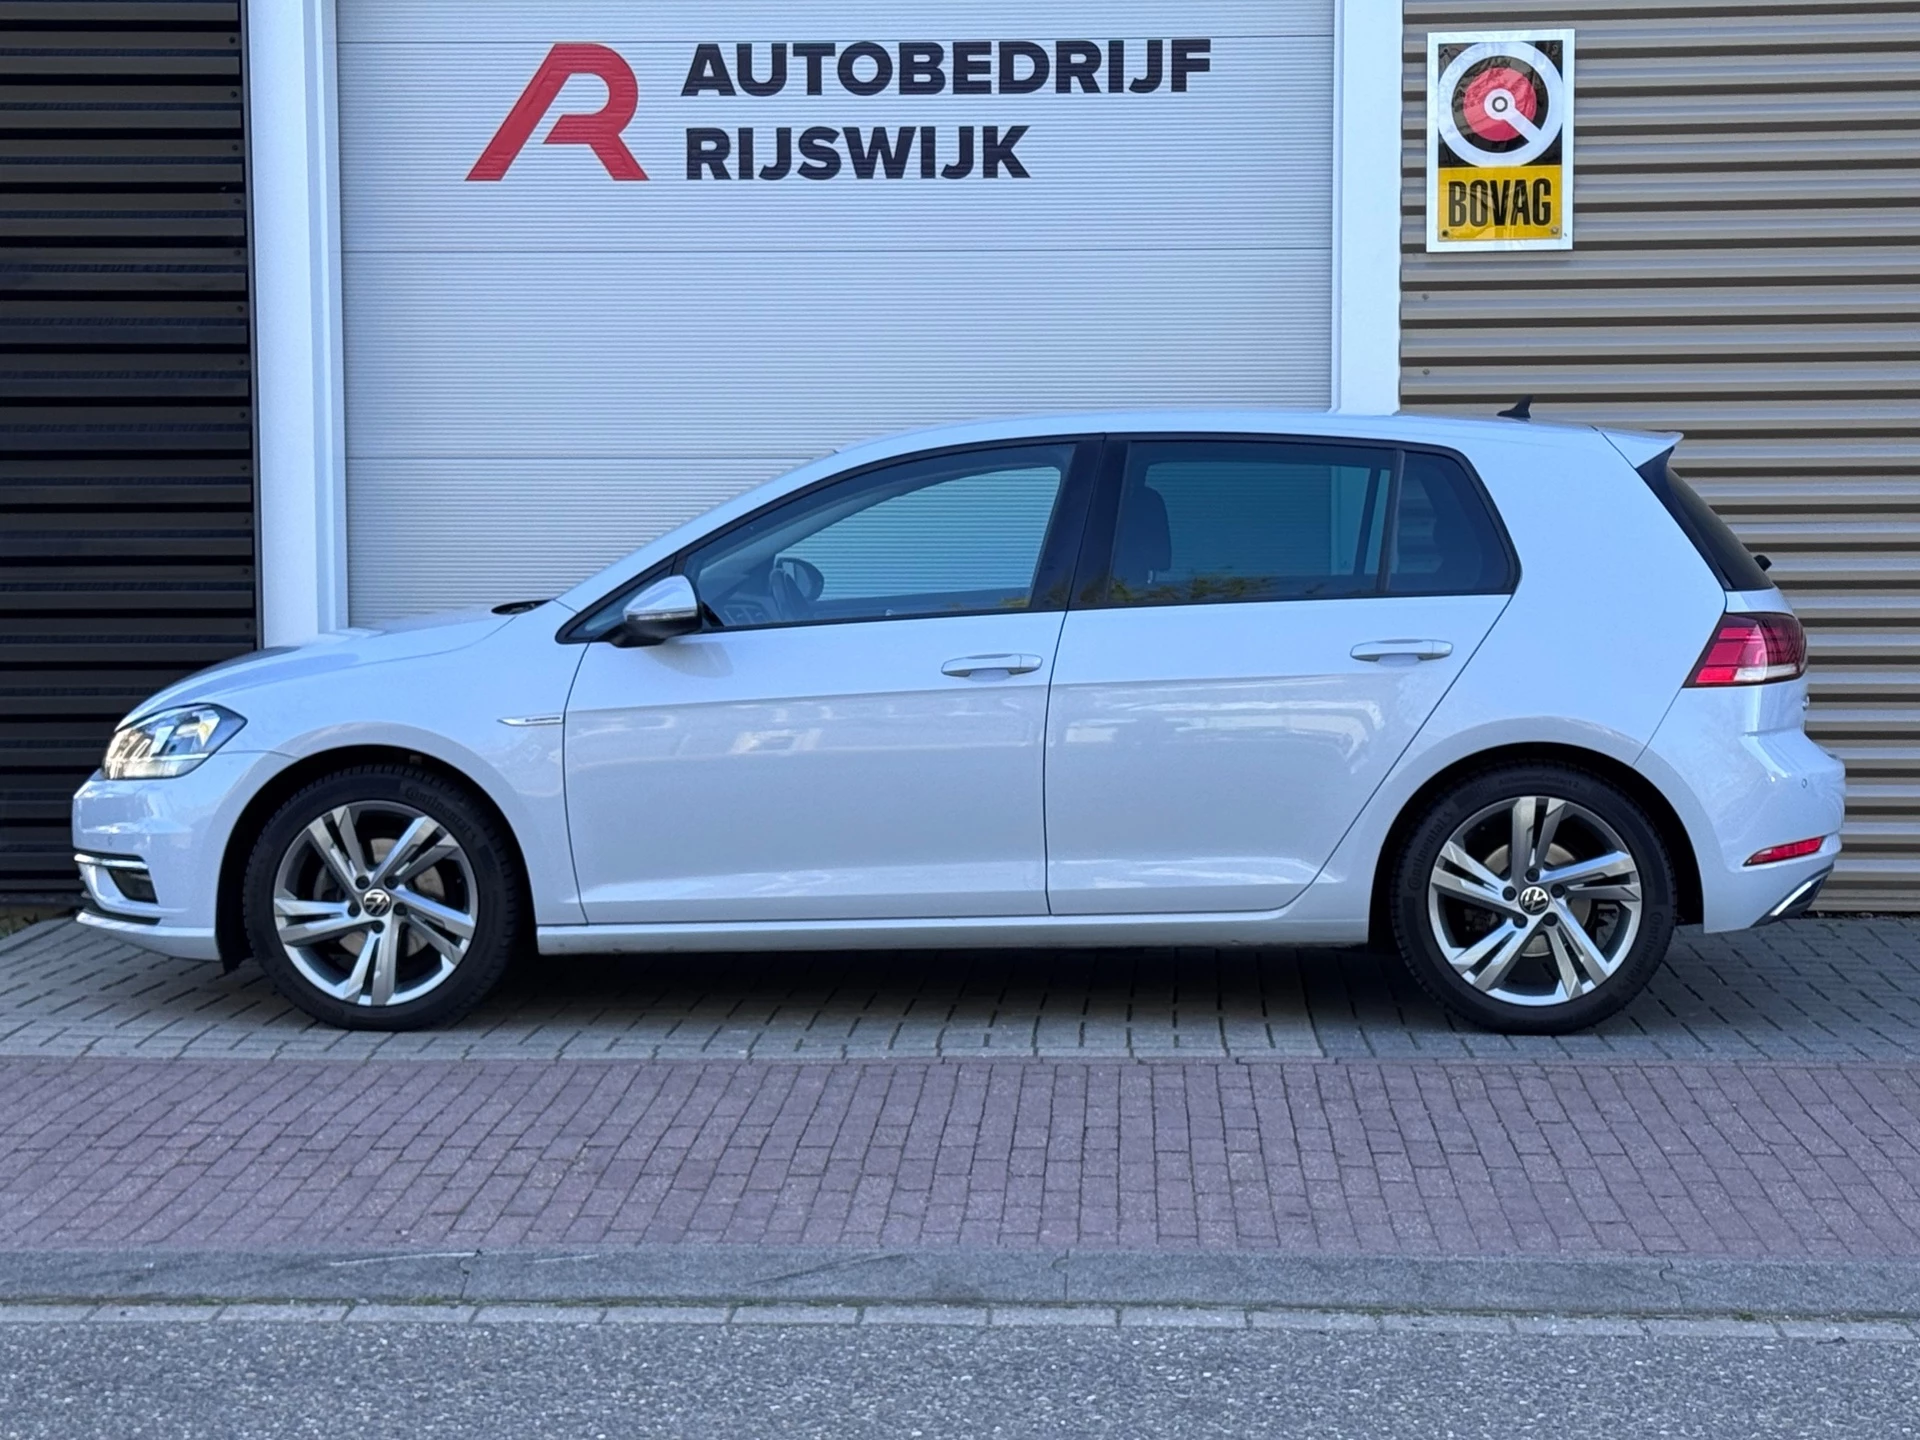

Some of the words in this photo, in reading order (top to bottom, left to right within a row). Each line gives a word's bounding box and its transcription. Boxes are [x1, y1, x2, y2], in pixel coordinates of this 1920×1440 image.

[682, 39, 1210, 96] AUTOBEDRIJF
[687, 126, 1029, 180] RIJSWIJK
[1448, 178, 1551, 227] BOVAG
